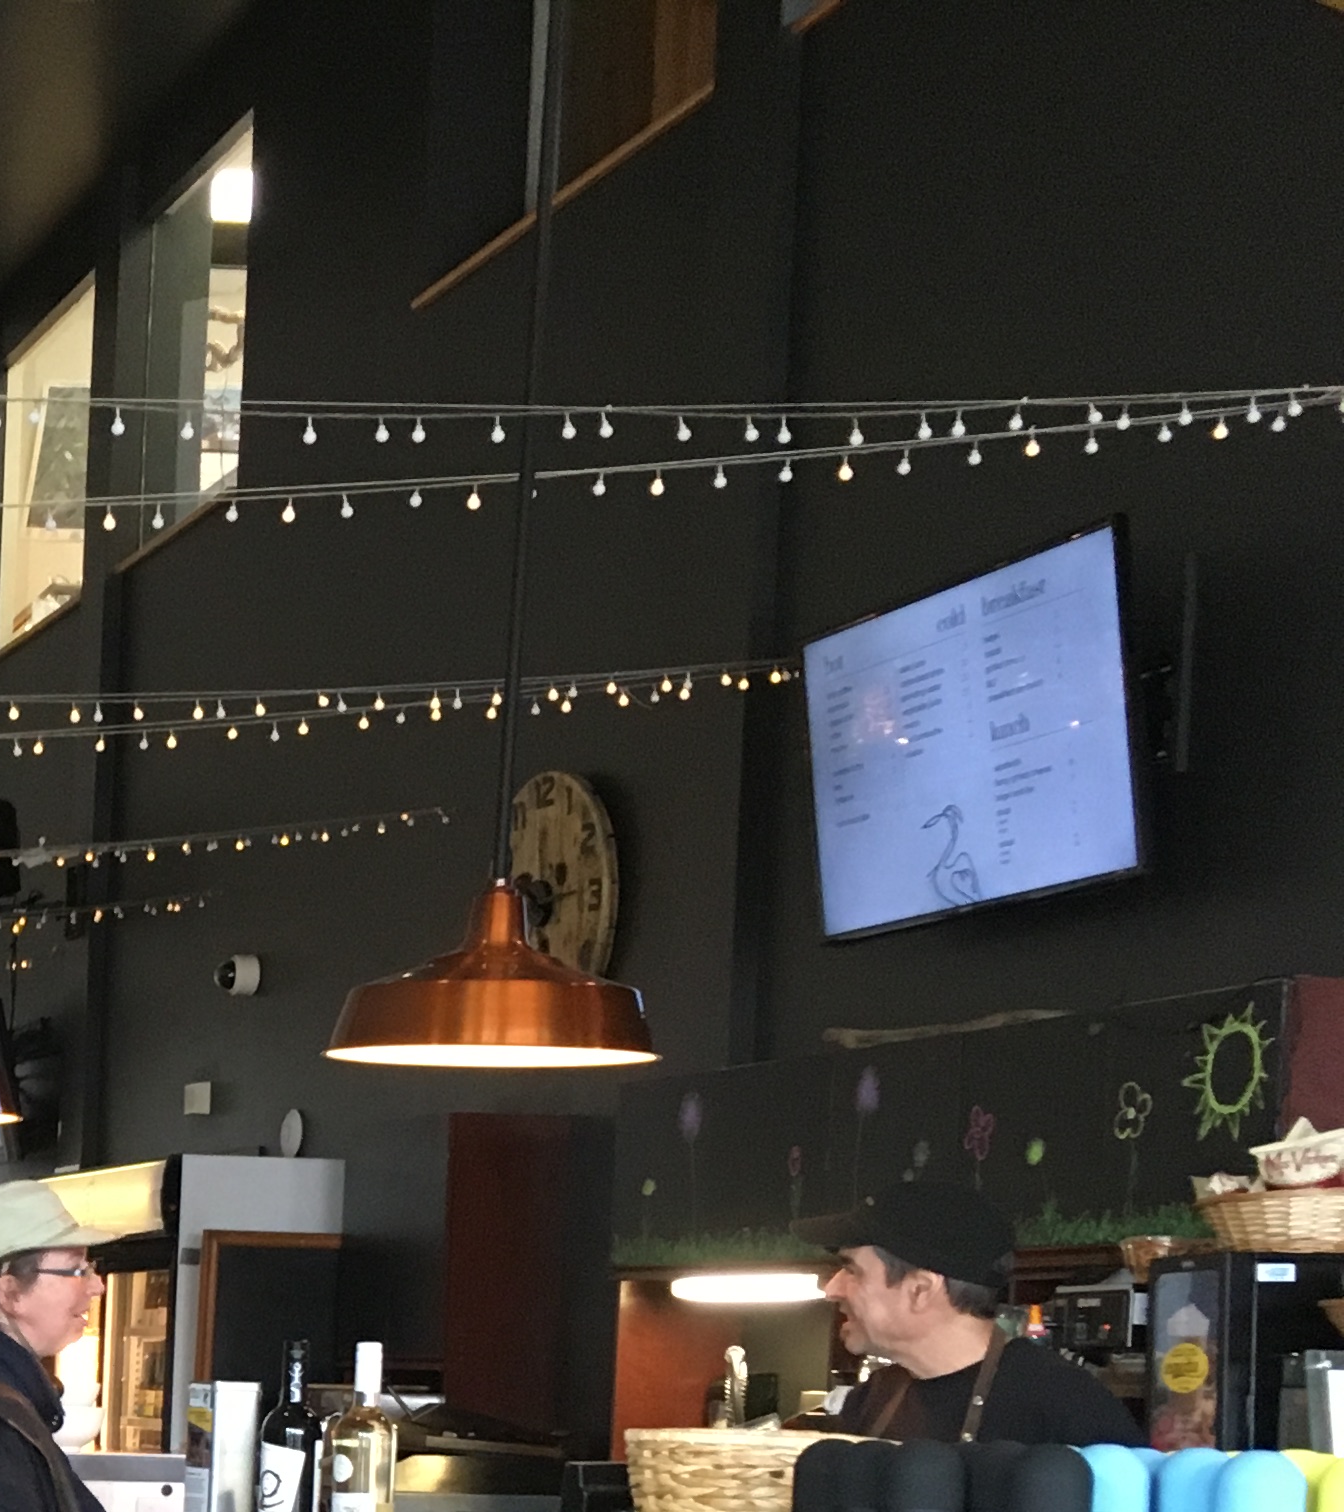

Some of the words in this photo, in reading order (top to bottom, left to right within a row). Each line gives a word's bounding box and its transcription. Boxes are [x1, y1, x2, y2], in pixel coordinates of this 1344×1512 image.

[534, 775, 555, 809] 12
[580, 821, 597, 856] 2
[587, 877, 603, 913] 3
